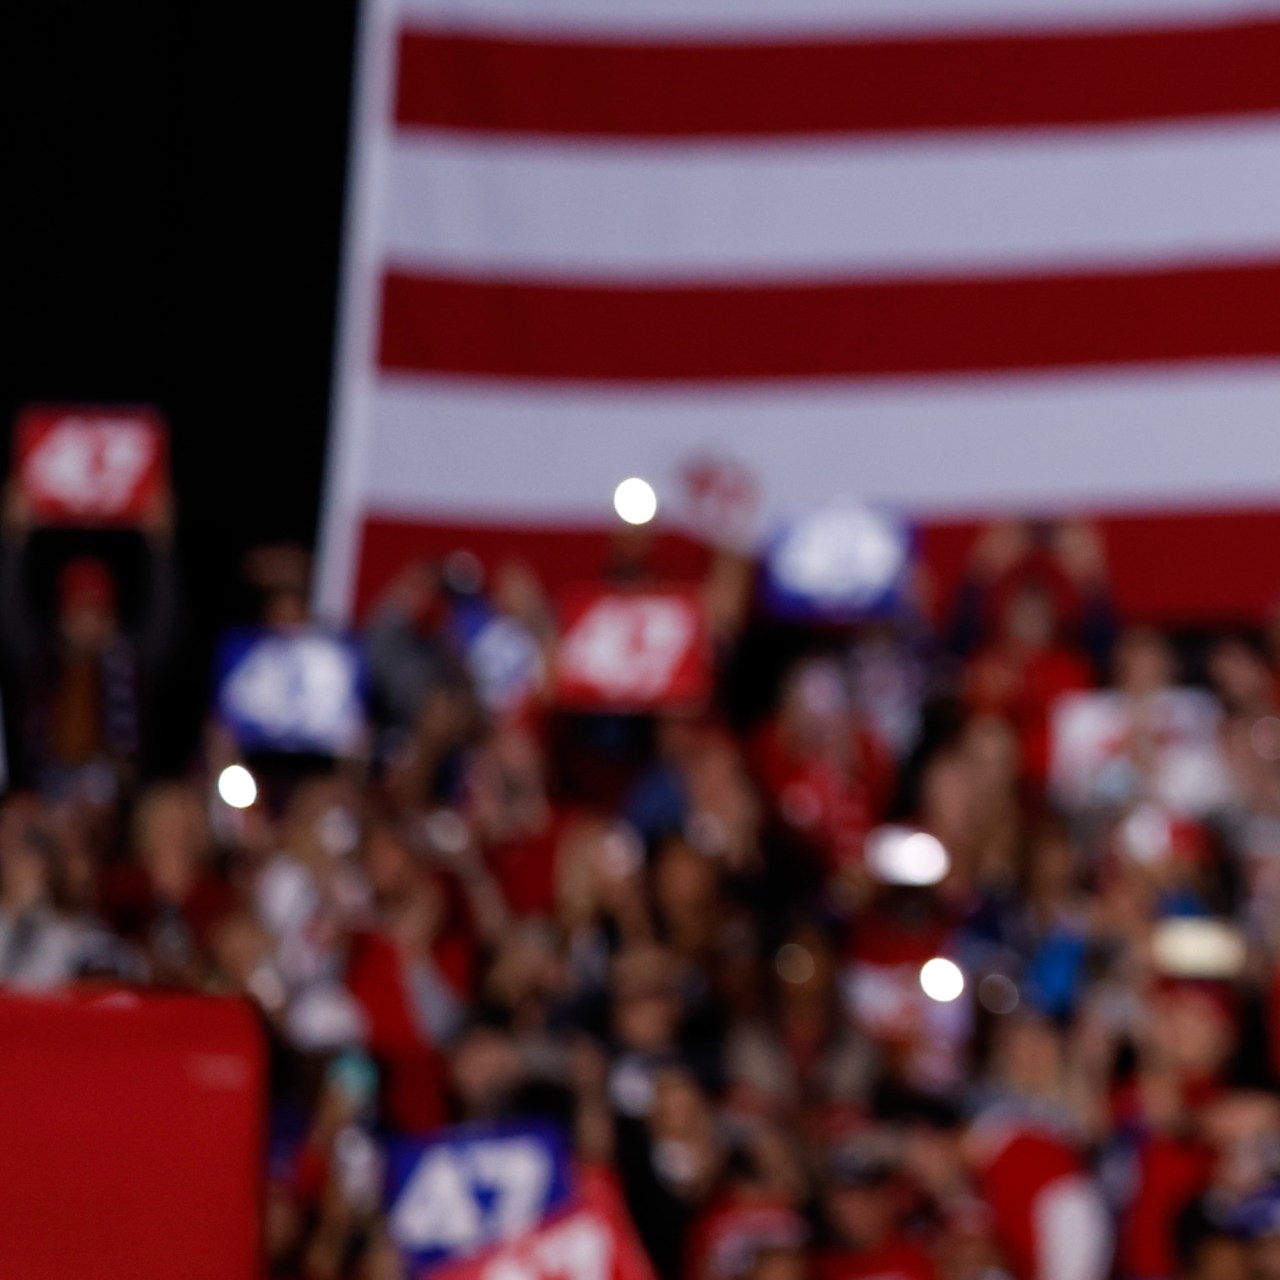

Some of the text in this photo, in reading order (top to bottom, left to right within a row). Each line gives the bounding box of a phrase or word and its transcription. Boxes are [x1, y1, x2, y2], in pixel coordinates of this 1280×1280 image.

[27, 414, 155, 513] 47
[556, 591, 699, 700] 47
[388, 1136, 554, 1256] 47
